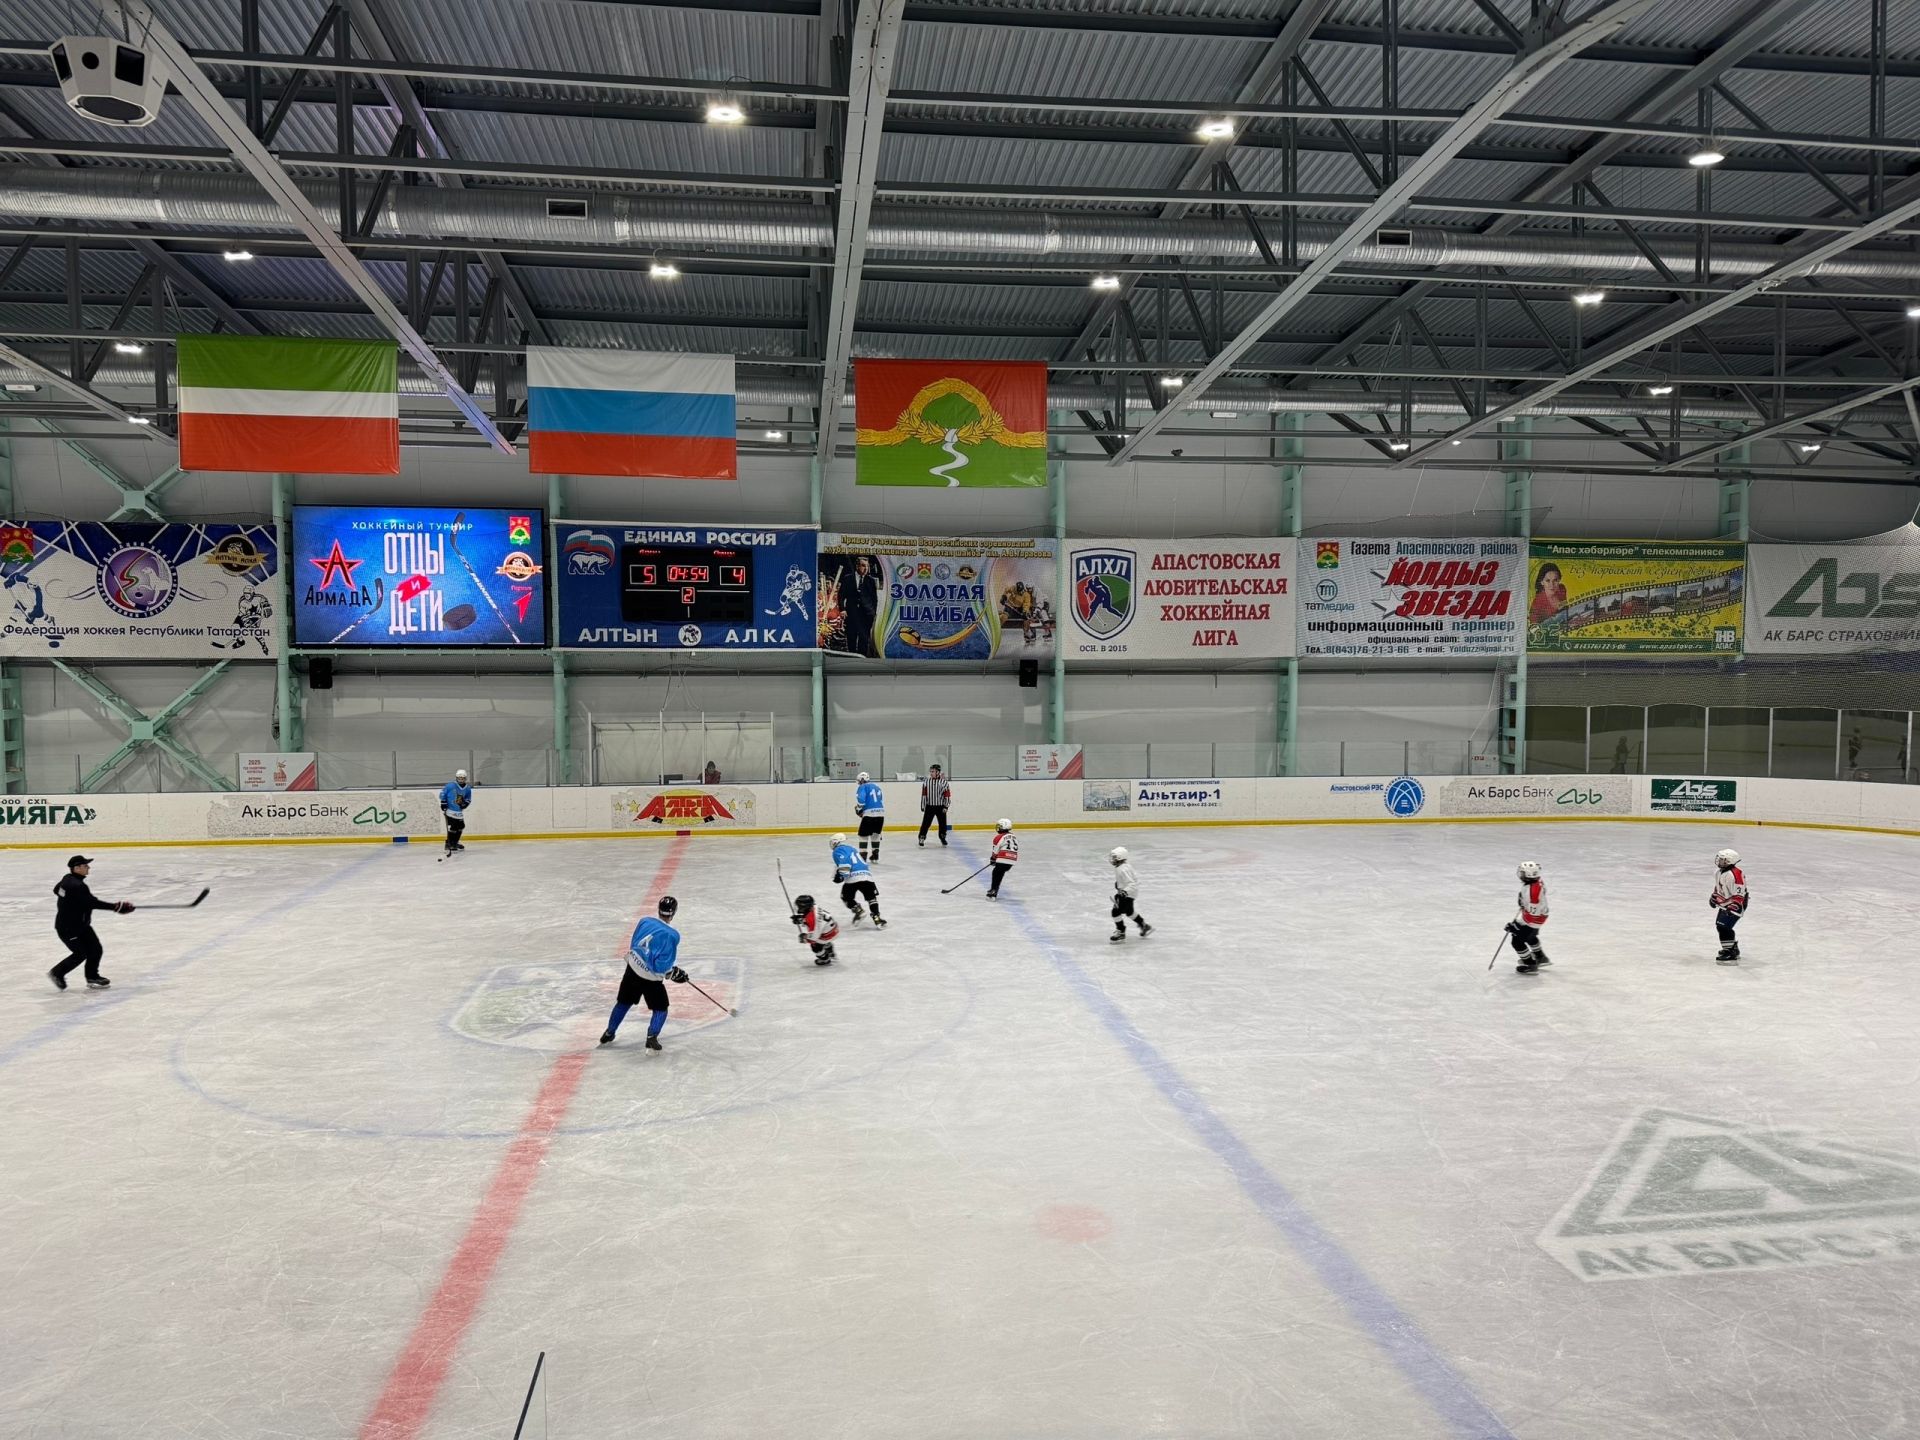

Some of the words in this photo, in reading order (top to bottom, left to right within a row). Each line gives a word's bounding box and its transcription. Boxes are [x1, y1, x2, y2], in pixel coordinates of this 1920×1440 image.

[352, 520, 424, 530] ХОККЕЙНЫЙ
[429, 522, 473, 531] ТУРНИР
[624, 530, 696, 544] ЕДИНАЯ
[706, 532, 777, 546] РОССИЯ
[384, 532, 444, 577] ОТЦЫ
[1351, 541, 1390, 555] Газета
[1396, 542, 1475, 556] Апастовского
[1480, 541, 1518, 557] района
[1079, 558, 1129, 577] АЛХЛ
[1151, 553, 1281, 570] АПАСТОВСКАЯ
[643, 566, 653, 583] 5
[669, 566, 707, 580] 04:54
[733, 568, 743, 583] 4
[1385, 557, 1499, 589] ЙОЛДЫЗ
[684, 588, 693, 602] 2
[890, 583, 985, 601] ЗОЛОТАЯ
[1143, 578, 1288, 596] ЛЮБИТЕЛЬСКАЯ
[389, 589, 444, 635] ДЕТИ
[899, 601, 977, 623] ШАЙБА
[1160, 599, 1270, 621] ХОККЕЙНАЯ
[1394, 590, 1511, 619] ЗВЕЗДА
[4, 625, 79, 638] Федерация
[84, 627, 125, 636] хоккея
[130, 625, 203, 637] Республики
[207, 626, 270, 637] Татарстан
[1307, 620, 1443, 633] информационный
[1452, 620, 1515, 632] партнер
[578, 628, 658, 643] АЛТЫН
[725, 629, 795, 643] АЛКА
[1192, 630, 1239, 646] ЛИГА
[1368, 635, 1430, 645] официальный
[1764, 630, 1784, 641] АК
[1787, 630, 1824, 641] БАРС
[1108, 644, 1128, 652] 2015
[1330, 784, 1370, 792] Апастовский
[1371, 784, 1384, 792] РЭС
[1468, 787, 1485, 798] Ак
[1489, 787, 1520, 799] Барс
[1522, 786, 1554, 798] Банк
[0, 805, 97, 825] ИЯГА»
[242, 805, 262, 818] Ак
[267, 805, 307, 820] Барс
[310, 803, 349, 817] Банк
[1575, 1245, 1680, 1276] АК
